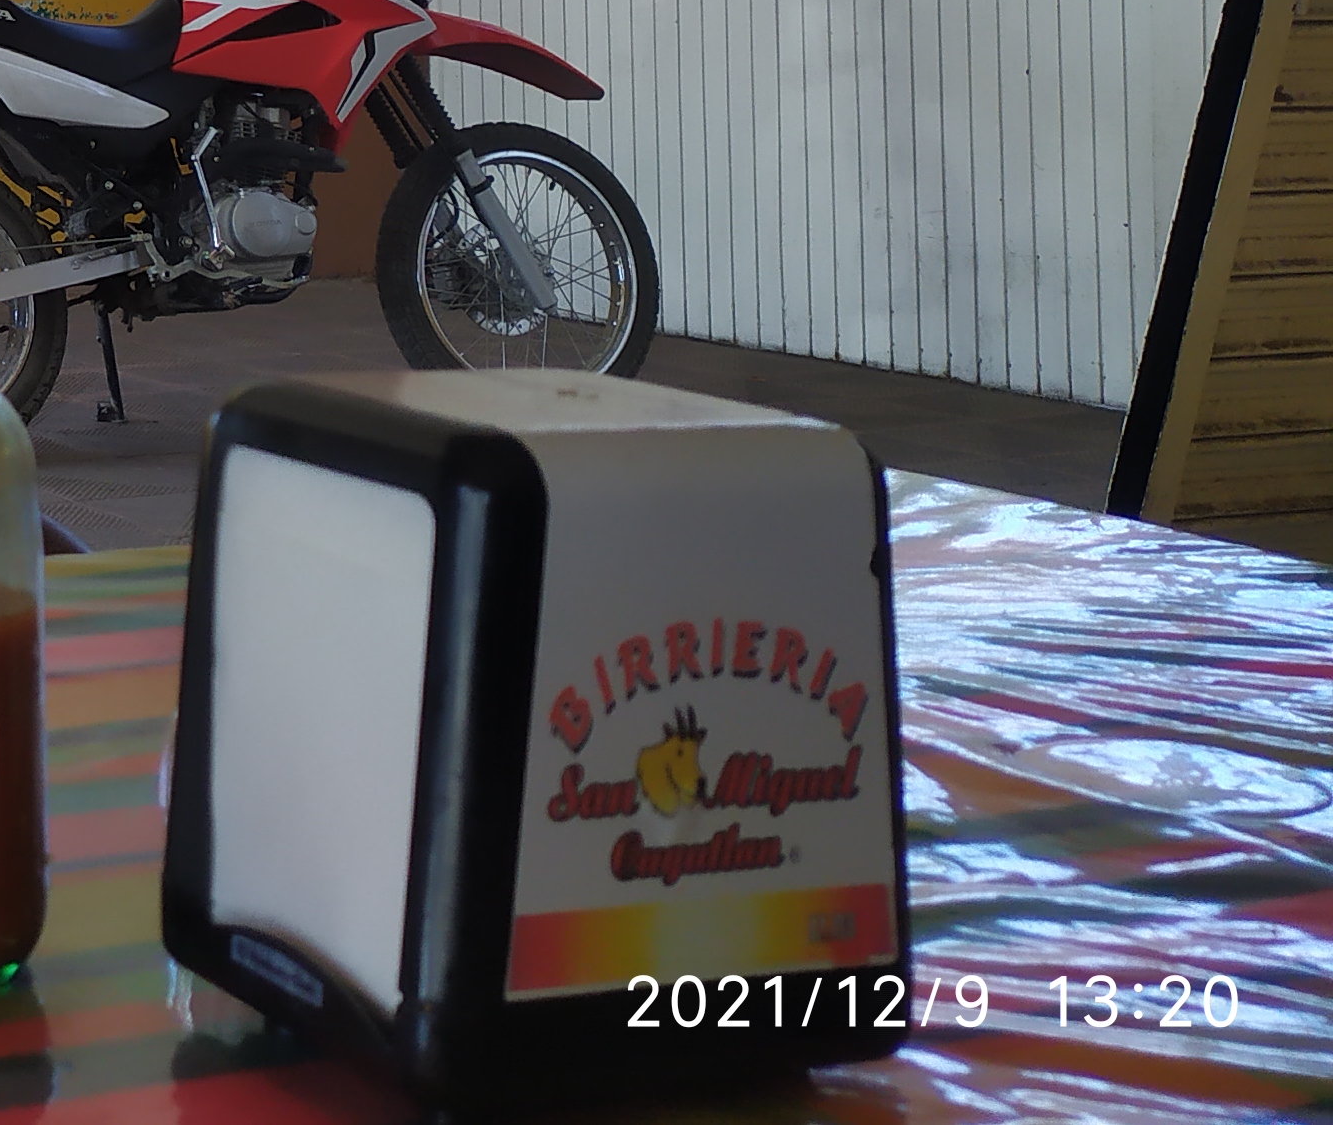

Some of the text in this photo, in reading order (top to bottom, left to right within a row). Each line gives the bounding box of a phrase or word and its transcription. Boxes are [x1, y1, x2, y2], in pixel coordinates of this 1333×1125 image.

[547, 616, 870, 754] BIRRIERIA
[546, 743, 863, 822] San Miguel
